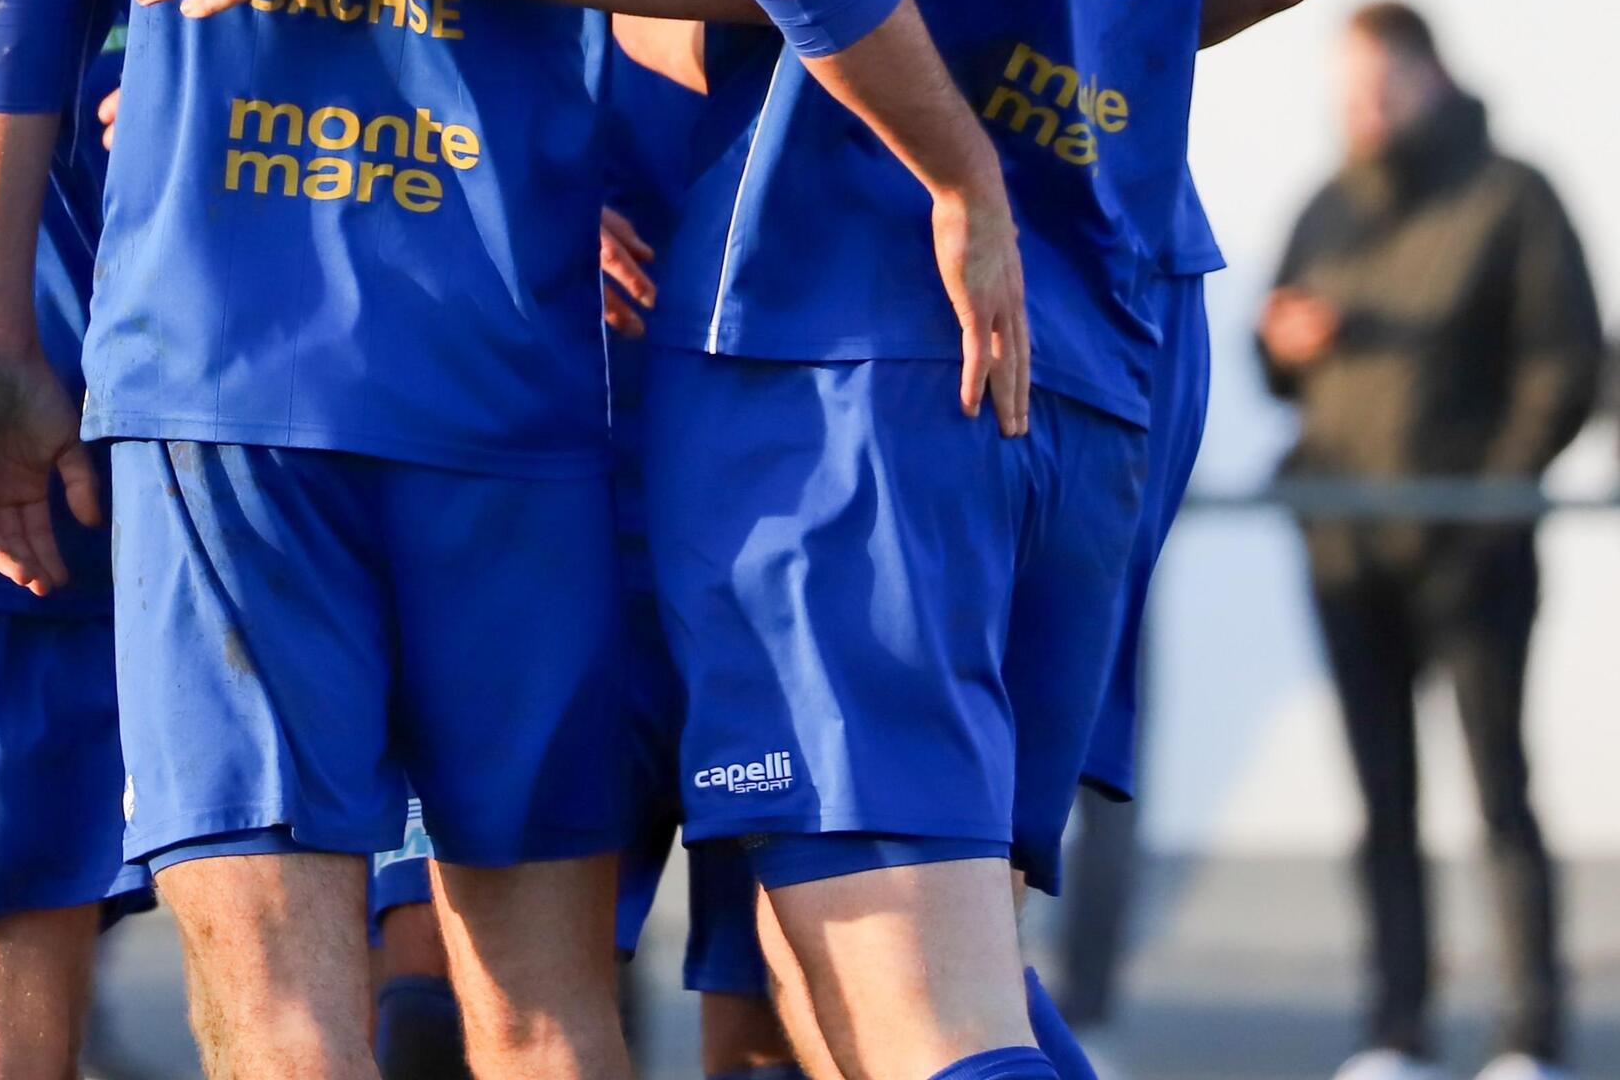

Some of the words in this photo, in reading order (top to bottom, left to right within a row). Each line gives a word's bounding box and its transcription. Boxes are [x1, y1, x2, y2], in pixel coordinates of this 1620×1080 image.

[229, 97, 480, 169] monte
[225, 148, 443, 213] mare
[694, 751, 792, 792] capelli
[735, 778, 794, 794] SPORT
